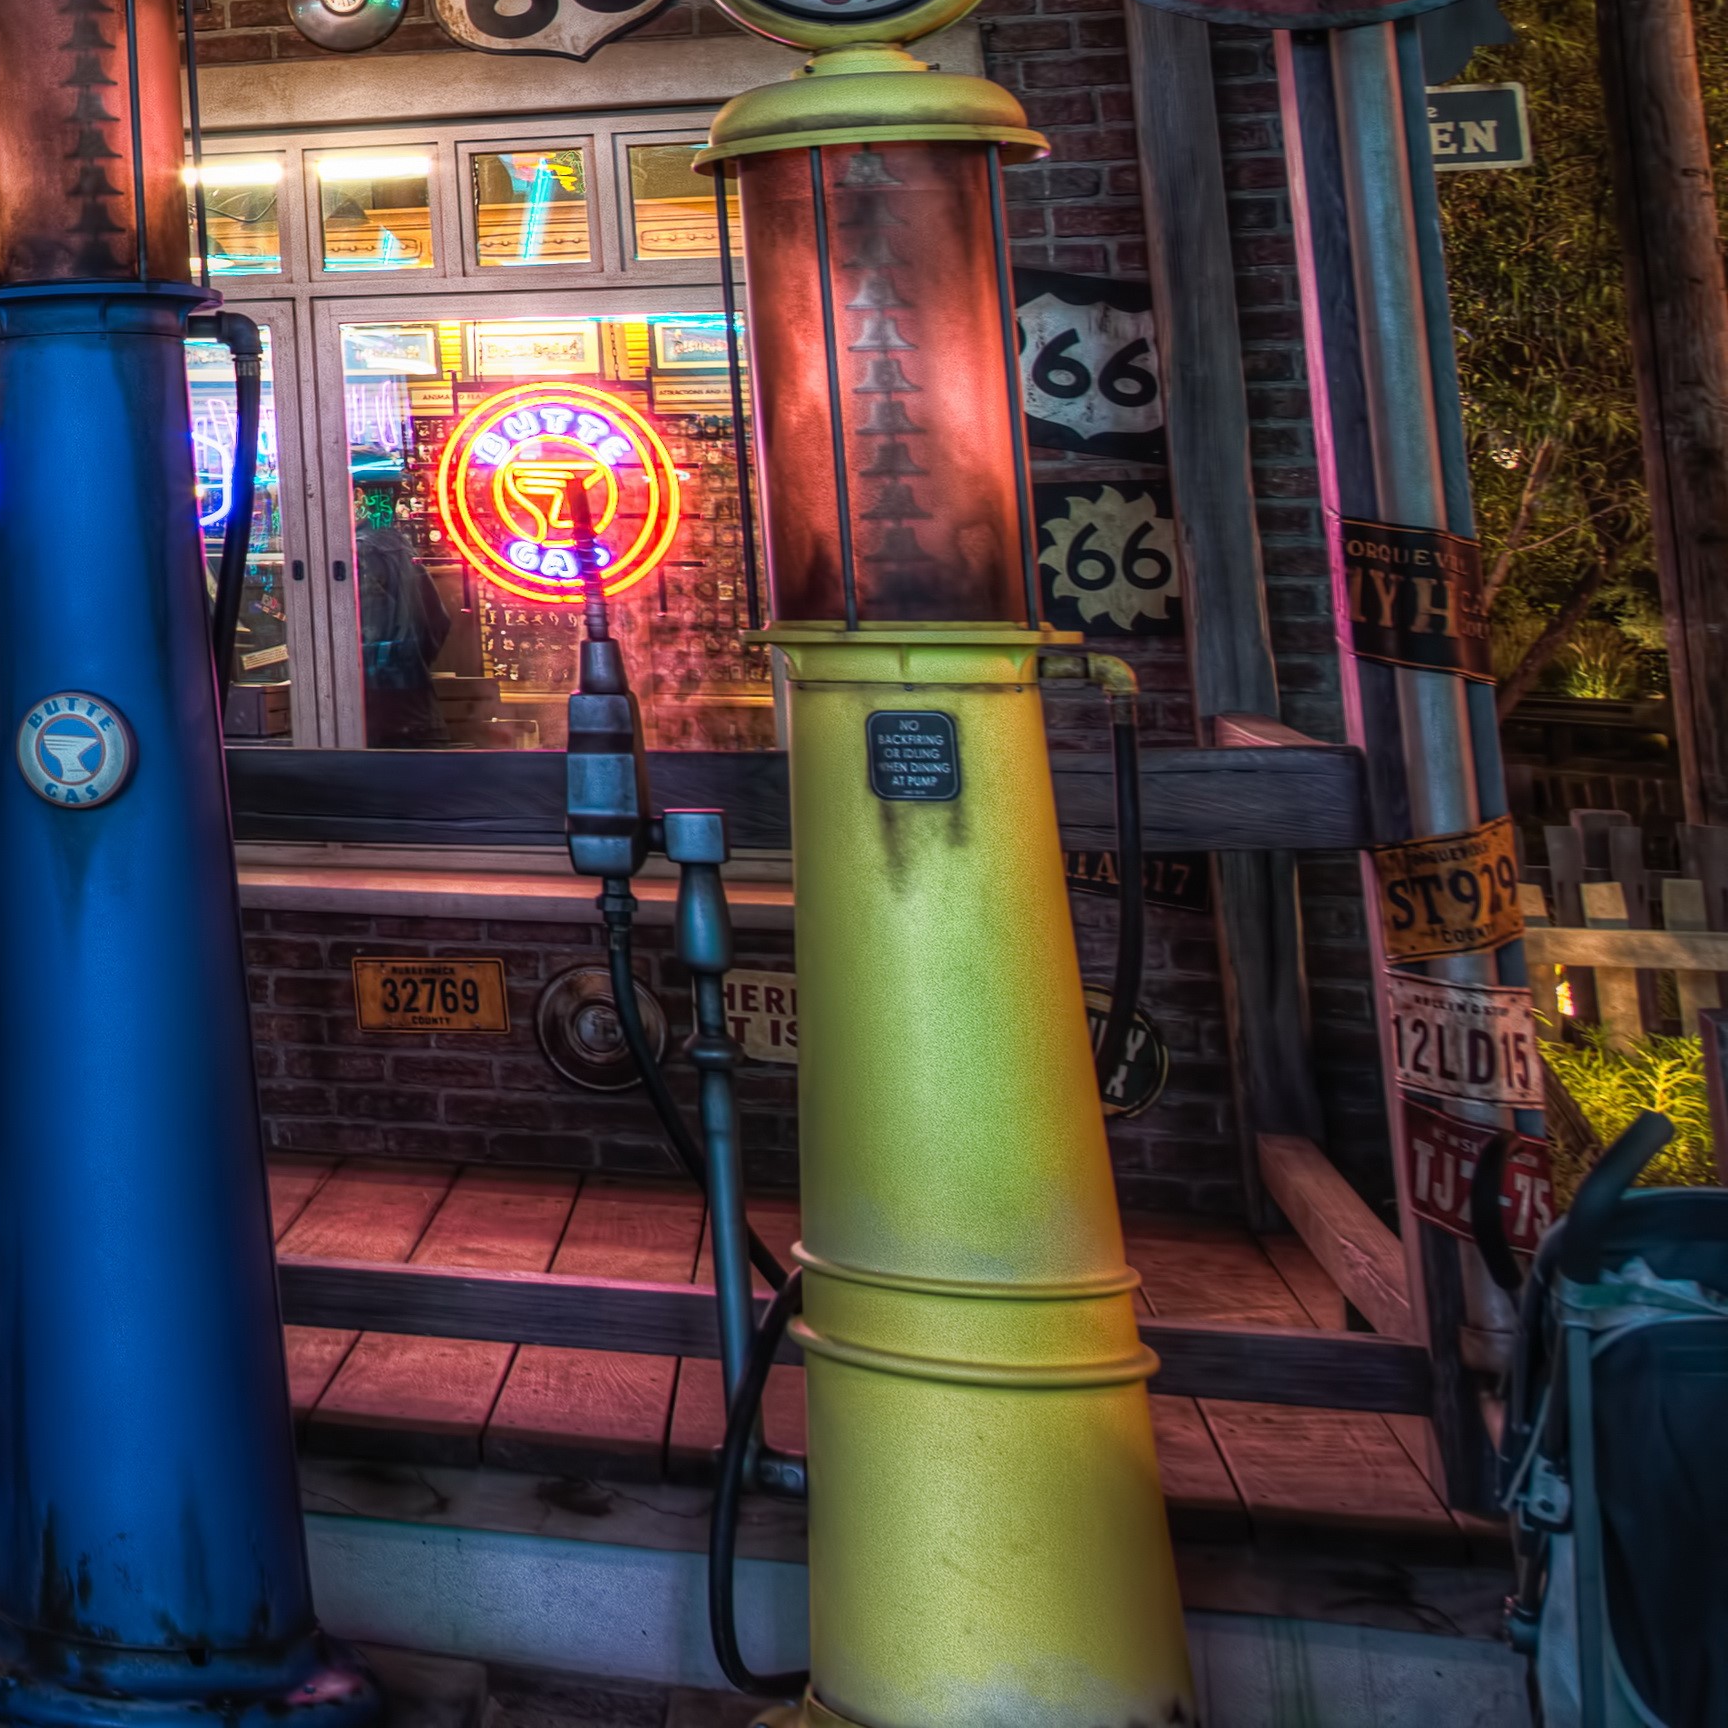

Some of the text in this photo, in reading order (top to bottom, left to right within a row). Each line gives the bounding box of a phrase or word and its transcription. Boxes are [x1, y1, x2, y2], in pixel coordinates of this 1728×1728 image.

[1031, 327, 1158, 409] 66
[473, 405, 637, 466] BUTTE
[1066, 520, 1172, 592] 66
[27, 697, 117, 732] BUTTE
[898, 719, 920, 732] NO
[877, 734, 944, 746] BACKFIRING
[885, 748, 941, 760] OR IDLING
[910, 762, 951, 774] DINING
[891, 775, 938, 787] AT PUMP
[44, 782, 101, 804] GAS
[380, 976, 481, 1015] 32769
